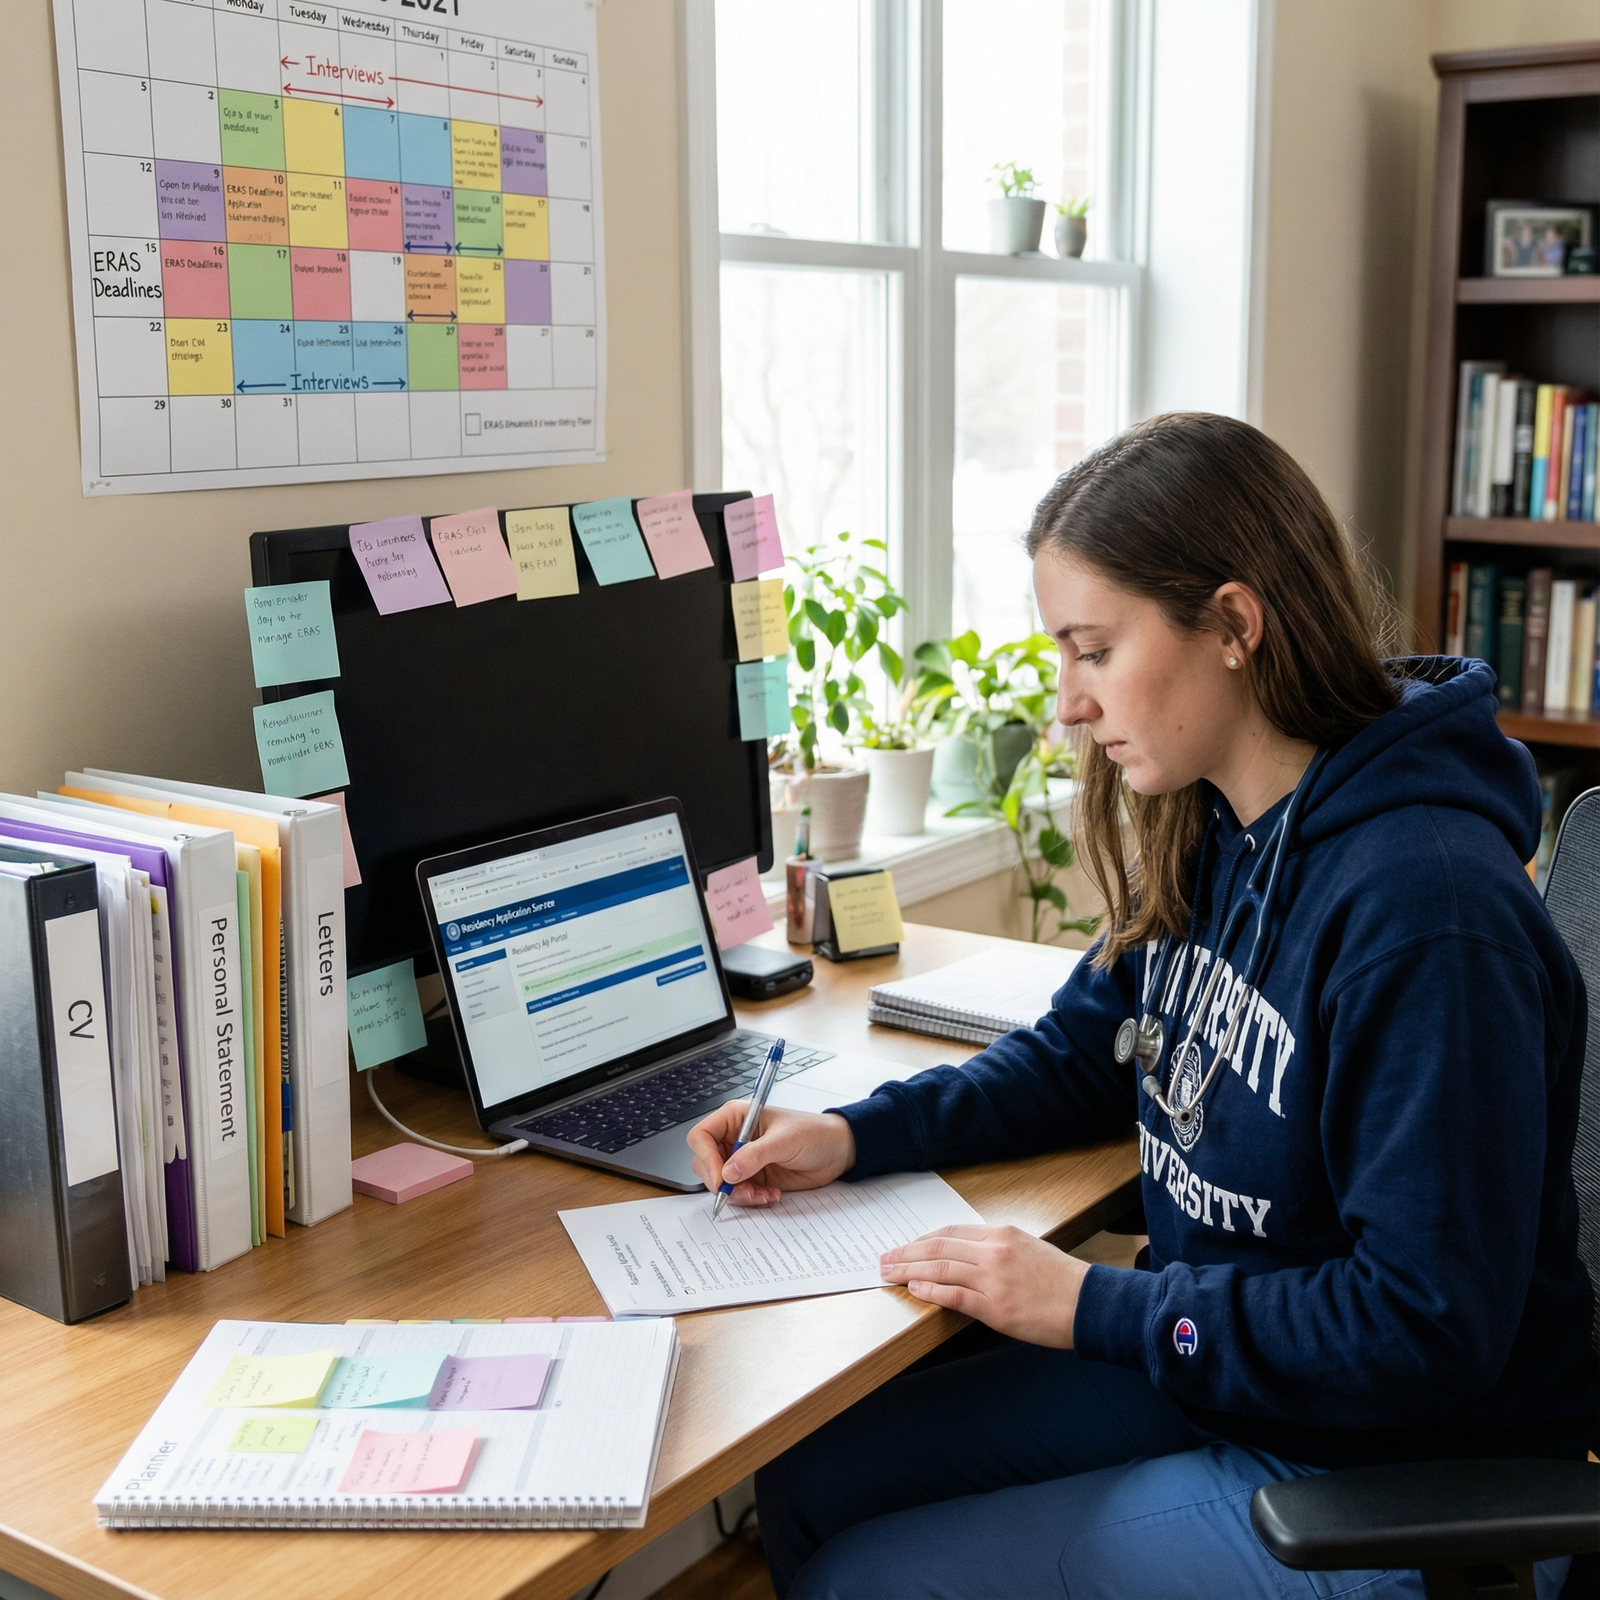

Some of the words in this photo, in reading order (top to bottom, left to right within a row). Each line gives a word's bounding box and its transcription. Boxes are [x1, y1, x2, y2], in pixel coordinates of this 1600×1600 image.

[289, 6, 327, 24] Tuesday
[402, 26, 440, 44] Thursday
[461, 37, 484, 52] Friday
[305, 55, 384, 85] Interviews
[141, 81, 148, 92] 5
[389, 115, 396, 124] 7
[140, 162, 152, 173] 12
[213, 170, 220, 179] 9
[273, 175, 284, 185] 10
[333, 181, 342, 190] 11
[145, 243, 157, 253] 15
[213, 246, 224, 256] 16
[277, 249, 287, 259] 17
[337, 253, 346, 262] 18
[94, 251, 141, 272] ERAS
[165, 259, 185, 268] ERAS
[393, 257, 402, 265] 19
[93, 277, 163, 299] Deadlines
[150, 322, 162, 332] 22
[217, 323, 228, 332] 23
[280, 324, 291, 333] 24
[339, 325, 349, 334] 25
[393, 326, 404, 335] 26
[290, 372, 369, 391] Interviews
[154, 401, 166, 410] 29
[220, 399, 232, 408] 30
[282, 398, 292, 407] 31
[297, 625, 321, 638] ERAS
[460, 918, 496, 934] Residency
[318, 911, 334, 996] Letters
[211, 917, 234, 1017] Personal
[68, 1000, 95, 1039] CV
[216, 1022, 237, 1142] Statement
[125, 1440, 178, 1490] Planner
